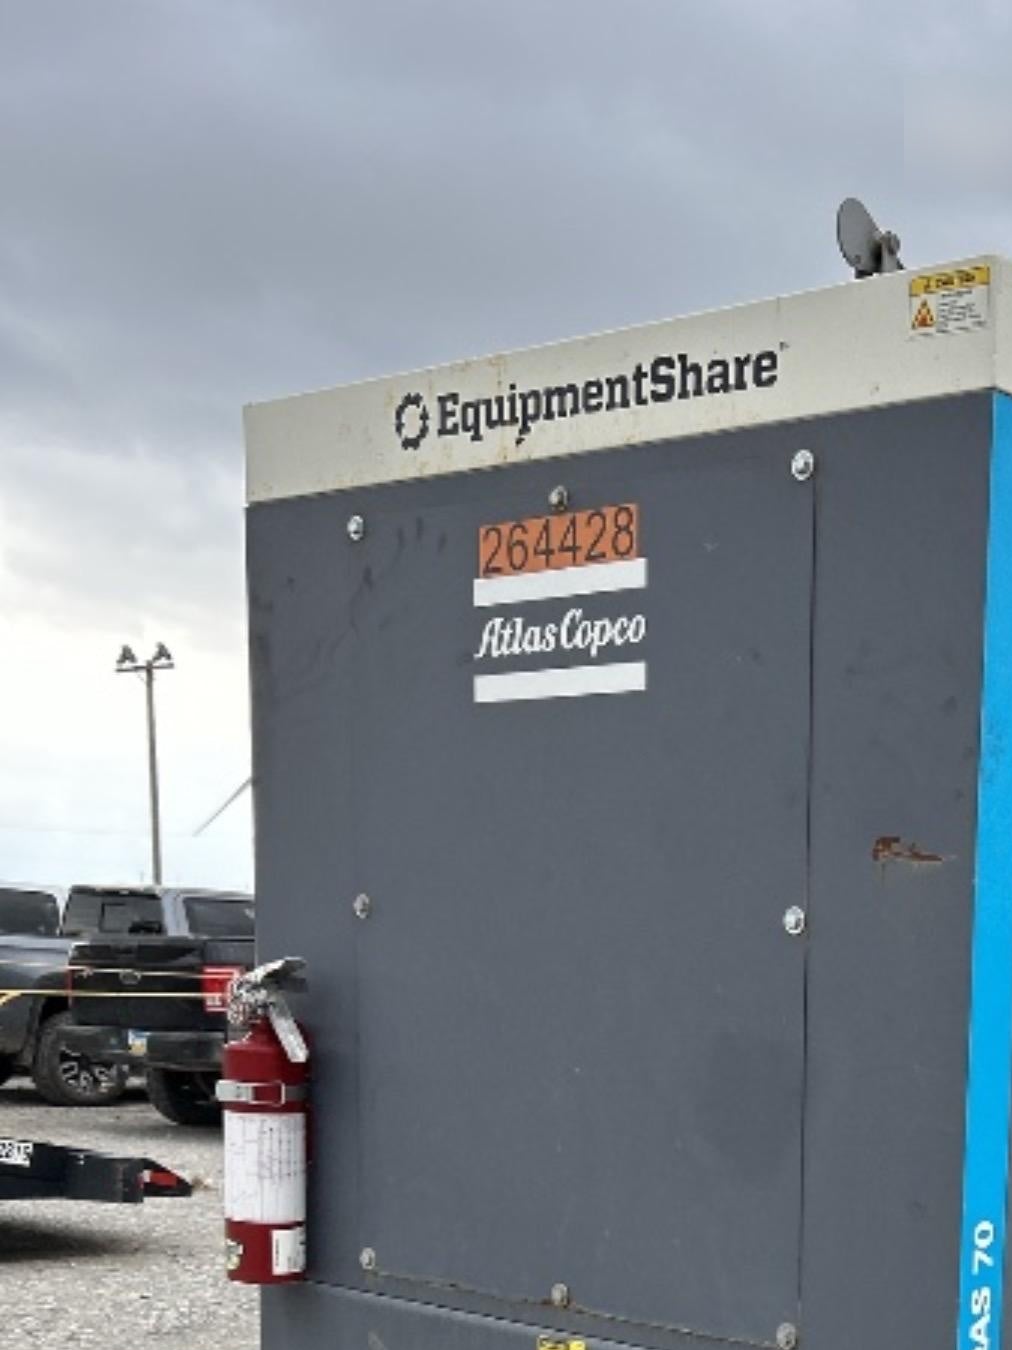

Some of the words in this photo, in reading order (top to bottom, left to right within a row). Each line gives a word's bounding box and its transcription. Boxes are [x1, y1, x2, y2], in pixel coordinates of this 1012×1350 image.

[437, 350, 779, 446] EquipmentShare
[483, 506, 634, 574] 264428
[474, 616, 558, 659] Atlas
[561, 608, 646, 657] Copco
[971, 1220, 994, 1276] 70
